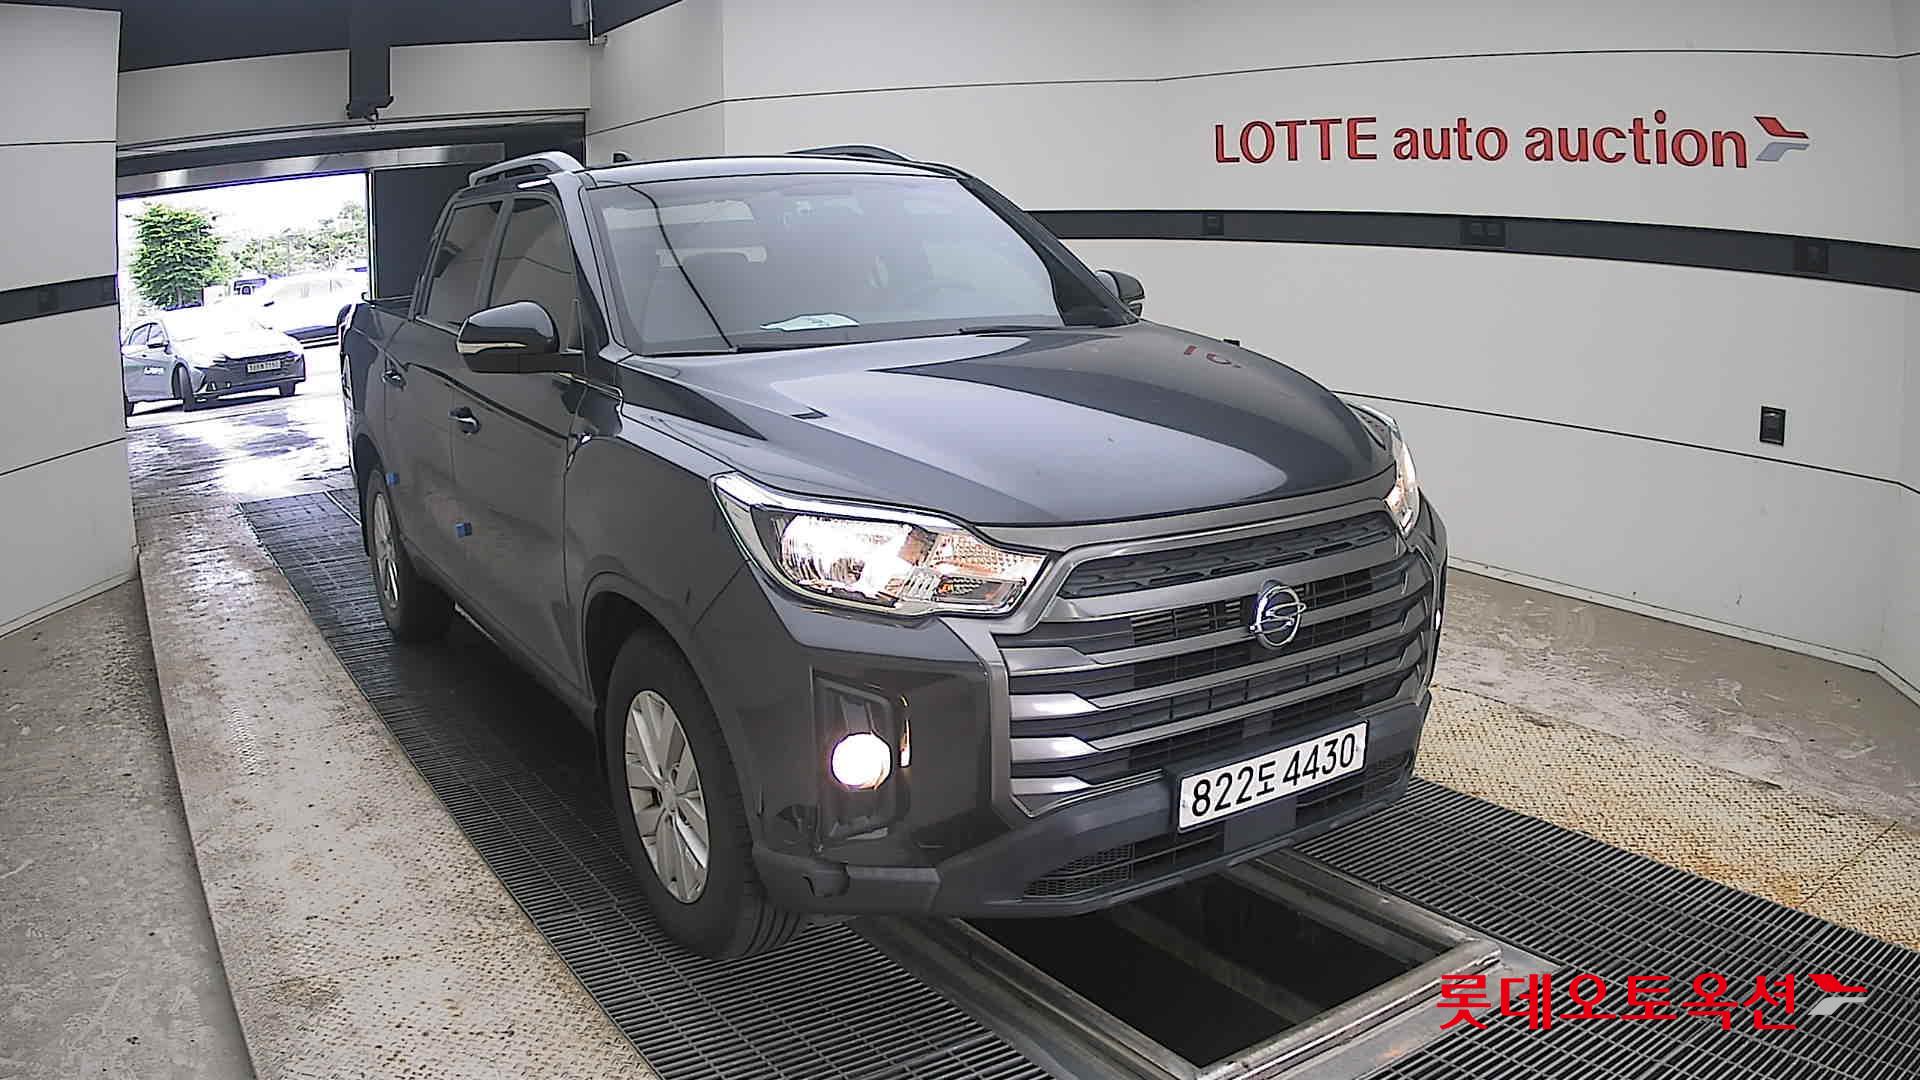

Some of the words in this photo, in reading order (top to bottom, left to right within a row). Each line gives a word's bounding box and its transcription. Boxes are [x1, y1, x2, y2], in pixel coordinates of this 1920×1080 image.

[1214, 116, 1377, 164] LOTTE
[1392, 117, 1509, 161] auto
[1524, 109, 1749, 168] auction
[1191, 760, 1276, 817] 822도
[1282, 733, 1356, 787] 4430
